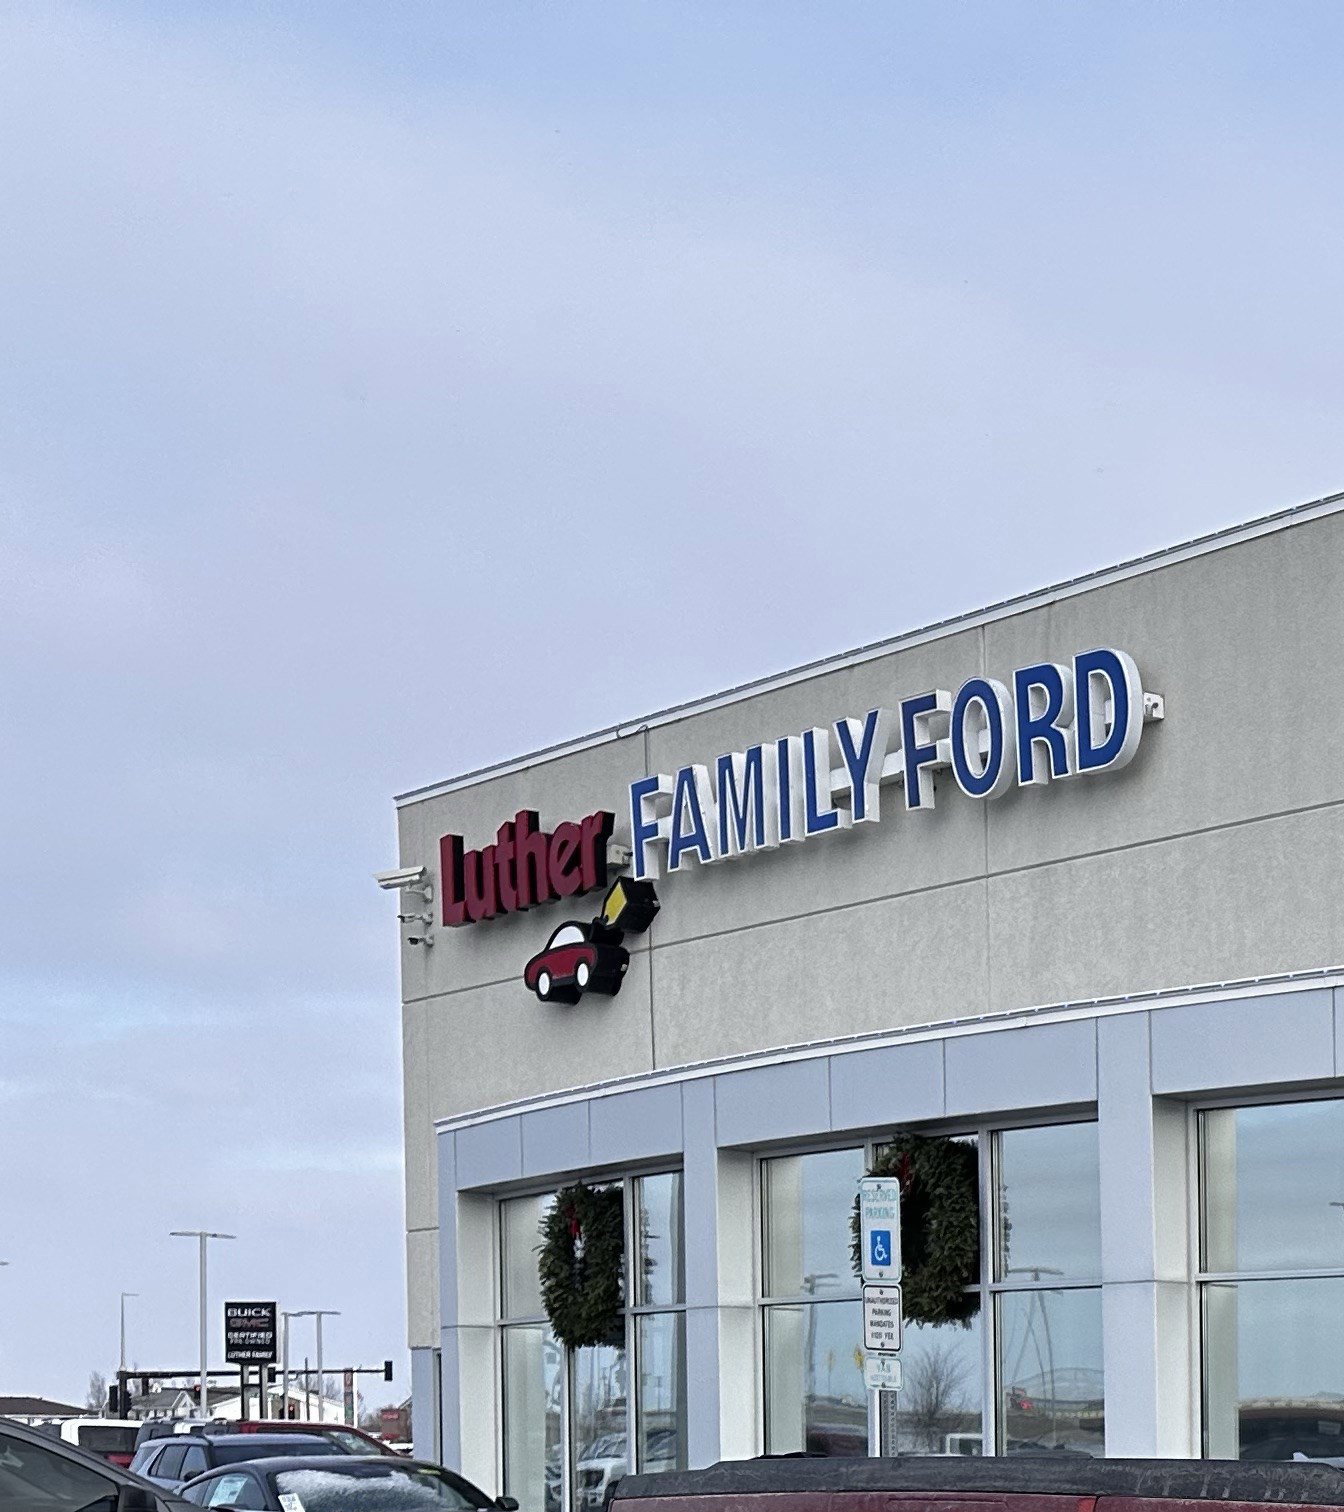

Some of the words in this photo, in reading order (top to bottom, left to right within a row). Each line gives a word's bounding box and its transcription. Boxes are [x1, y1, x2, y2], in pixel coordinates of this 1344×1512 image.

[629, 709, 885, 881] FAMILY
[898, 647, 1142, 811] FORD
[440, 809, 614, 928] Luther
[227, 1307, 271, 1317] BUICK
